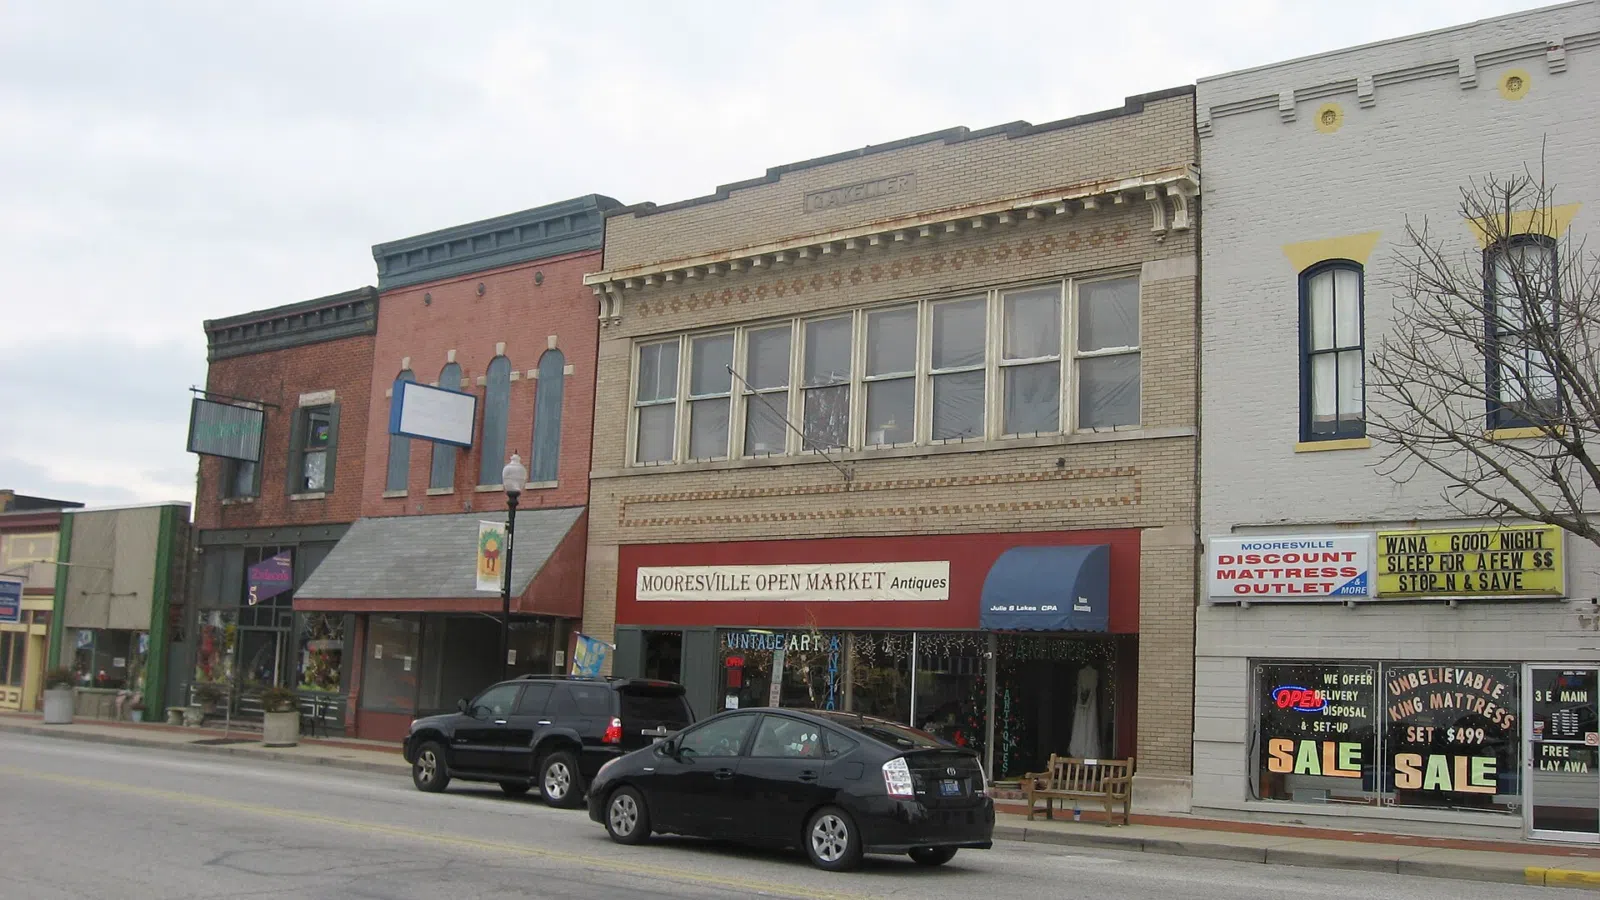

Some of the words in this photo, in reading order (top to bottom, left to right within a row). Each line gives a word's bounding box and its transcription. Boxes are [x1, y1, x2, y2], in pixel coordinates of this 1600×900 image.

[1241, 541, 1334, 551] MOORESVILLE
[1386, 536, 1428, 554] WANA
[1451, 533, 1490, 551] GOOD
[1500, 531, 1544, 550] NIGHT
[1218, 552, 1357, 565] DISCOUNT
[1387, 554, 1434, 572] SLEEP
[1439, 554, 1465, 571] FOR
[1477, 553, 1486, 571] A
[1490, 552, 1524, 570] FEW
[1533, 551, 1553, 568] $$
[641, 571, 750, 592] MOORESVILLE
[755, 573, 800, 591] OPEN
[805, 571, 886, 592] MARKET
[890, 576, 946, 591] Antiques
[1216, 567, 1358, 580] MATTRESS
[1463, 574, 1473, 590] &
[1479, 572, 1523, 590] SAVE
[248, 585, 257, 606] 5
[1233, 582, 1335, 595] OUTLET
[1340, 586, 1367, 594] MORE
[727, 632, 784, 650] VINTAGE
[789, 634, 822, 651] ART
[1323, 674, 1338, 684] WE
[1342, 674, 1373, 685] OFFER
[1388, 667, 1505, 700] UNBELIEVABLE
[1276, 689, 1323, 708] OPEN
[1314, 690, 1358, 701] DELIVERY
[1535, 690, 1542, 702] 3
[1545, 690, 1552, 702] E
[1560, 691, 1588, 703] MAIN
[1323, 706, 1367, 718] DISPOSAL
[1388, 696, 1423, 722] KING
[1430, 692, 1515, 730] MATTRESS
[1301, 721, 1307, 731] &
[1313, 721, 1348, 733] SET-UP
[1406, 726, 1434, 743] SET
[1446, 727, 1485, 745] $499
[1268, 738, 1362, 778] SALE
[1542, 745, 1569, 757] FREE
[1394, 753, 1497, 794] SALE
[1540, 760, 1560, 771] LAY
[1563, 760, 1588, 774] AWA
